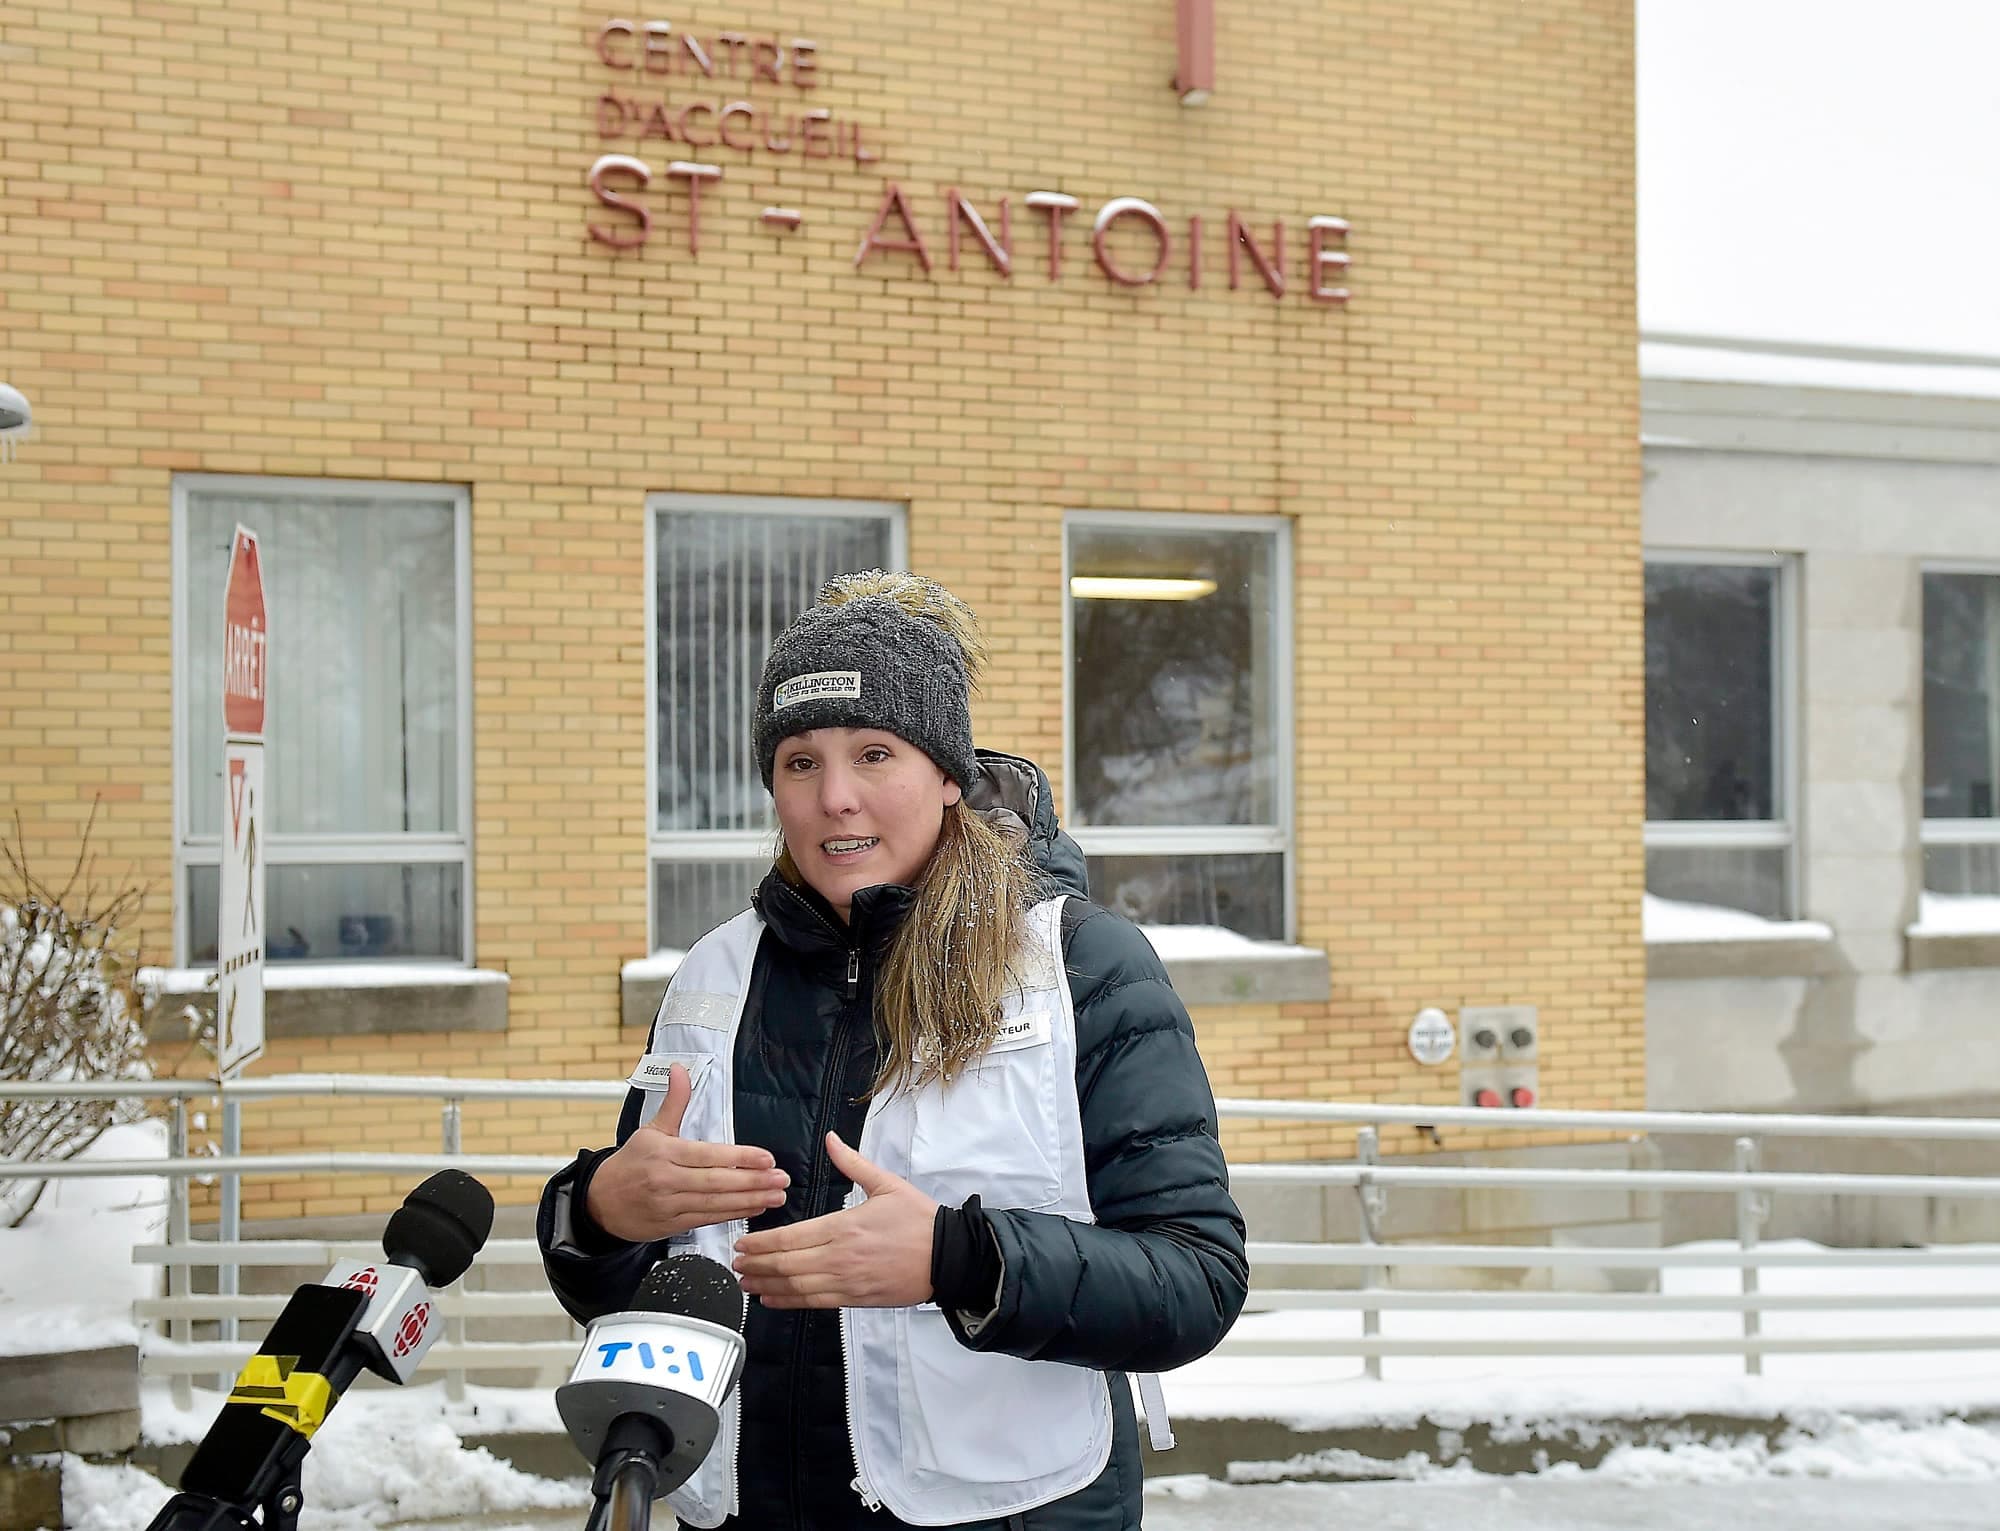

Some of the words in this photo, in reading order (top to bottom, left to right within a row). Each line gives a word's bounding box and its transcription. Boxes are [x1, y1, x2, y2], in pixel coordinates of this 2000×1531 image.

[598, 18, 818, 89] CENTRE
[597, 94, 880, 164] D'ACCUEIL
[587, 154, 722, 258] ST
[854, 182, 1351, 303] ANTOINE
[226, 615, 266, 700] ARRÊT
[790, 677, 855, 692] KILLINGTON
